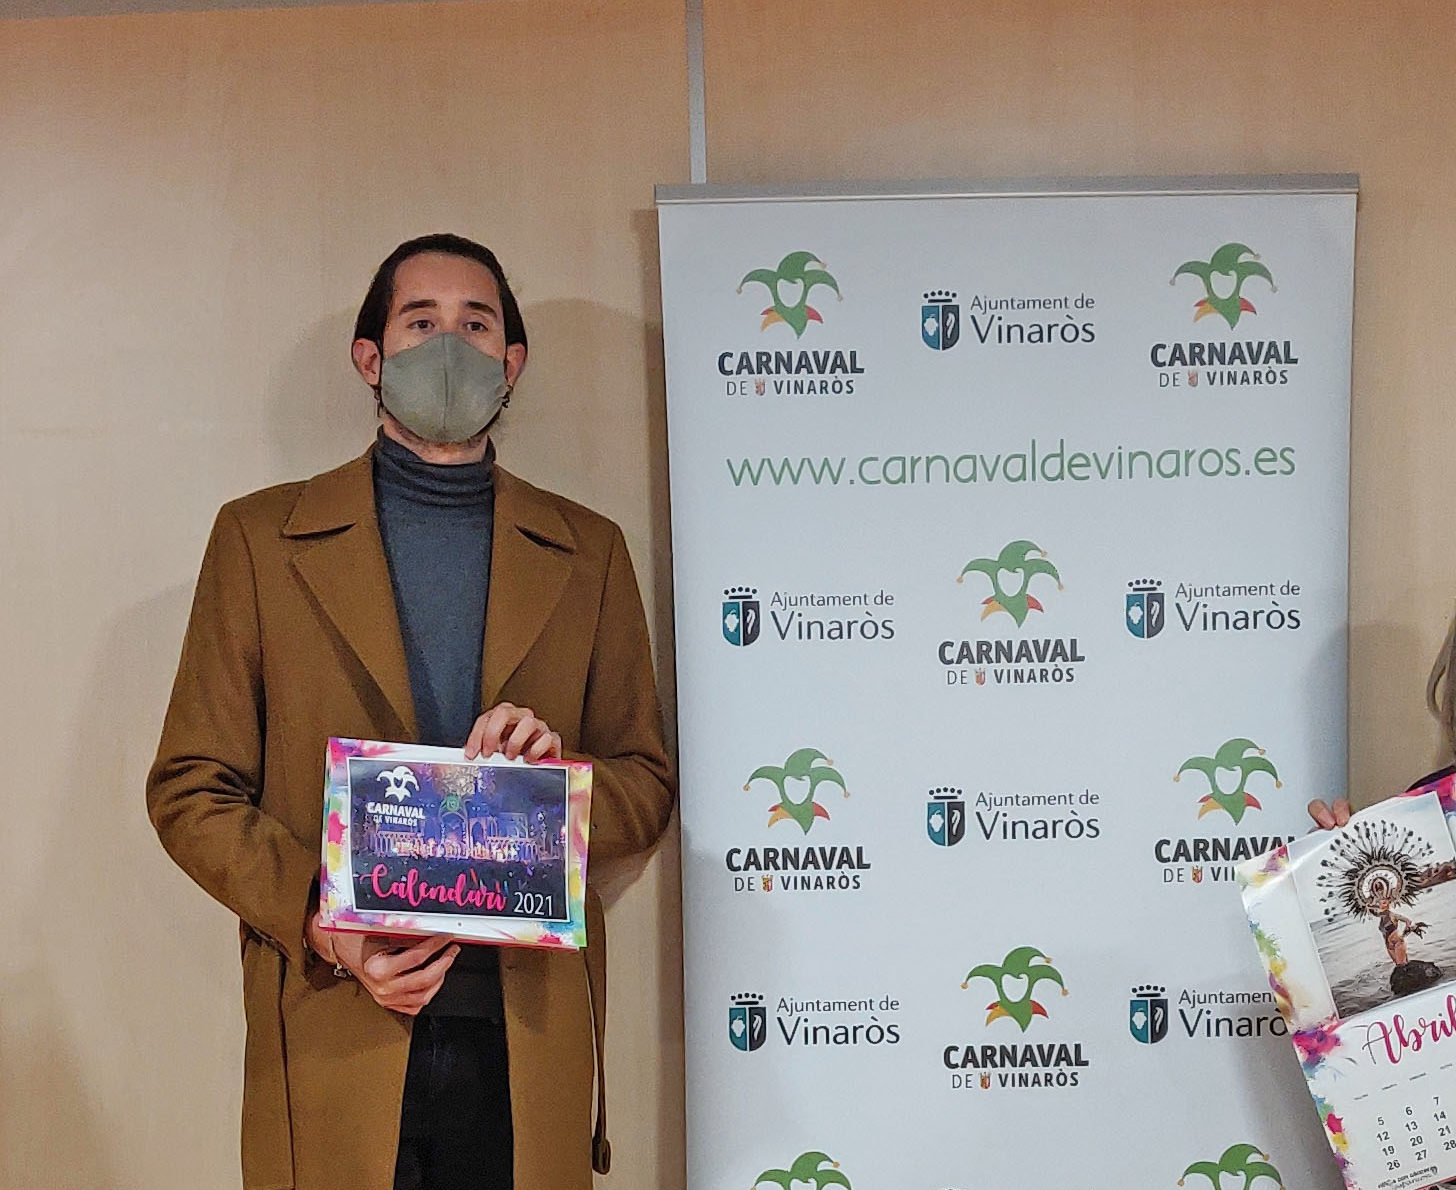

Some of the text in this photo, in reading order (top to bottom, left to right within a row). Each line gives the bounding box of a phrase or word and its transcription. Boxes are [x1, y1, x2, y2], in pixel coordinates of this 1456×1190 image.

[971, 293, 1095, 315] Ajuntament de
[970, 314, 1095, 344] Vinaròs
[718, 351, 865, 379] CARNAVAL
[1151, 341, 1298, 369] CARNAVAL
[727, 376, 854, 395] DE VINARÒS
[1160, 366, 1288, 387] DE VINARÒS
[727, 440, 1295, 486] www.carnavaldevinaros.es
[771, 590, 894, 611] Ajuntament de
[1175, 580, 1300, 603] Ajuntament de
[770, 611, 894, 640] Vinaròs
[1175, 601, 1300, 631] Vinaròs
[939, 639, 1085, 667] CARNAVAL
[948, 664, 1074, 685] DE VINARÒS
[366, 801, 426, 819] CARNAVAL
[976, 789, 1099, 811] Ajuntament de
[976, 810, 1100, 840] Vinaròs
[726, 846, 871, 872] CARNAVAL
[734, 871, 860, 892] DE VINARÒS
[1164, 868, 1184, 883] DE
[360, 863, 553, 916] Calendari 2021
[777, 995, 899, 1017] Ajuntament de
[1178, 988, 1277, 1008] Ajuntamen
[777, 1016, 900, 1045] Vinaròs
[1178, 1006, 1289, 1038] Vinarò
[944, 1043, 1089, 1069] CARNAVAL
[952, 1068, 1078, 1088] DE VINARÒS
